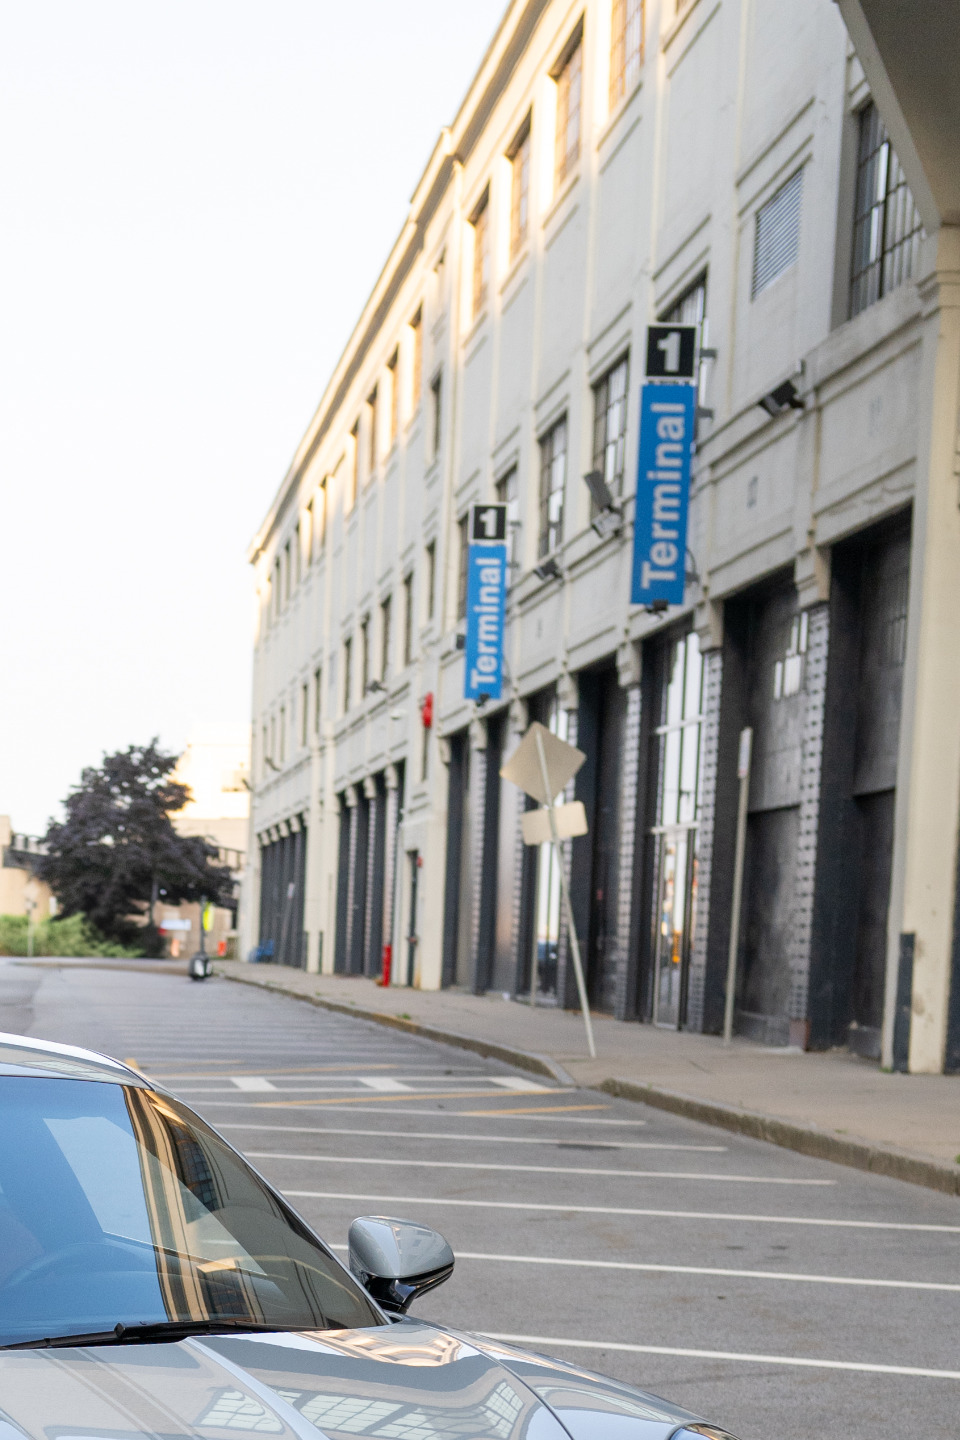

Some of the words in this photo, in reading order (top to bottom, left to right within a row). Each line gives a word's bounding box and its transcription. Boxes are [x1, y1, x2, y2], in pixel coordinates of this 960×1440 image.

[658, 332, 681, 372] 1
[479, 509, 498, 538] 1
[641, 401, 686, 590] Terminal
[470, 557, 501, 690] Terminal
